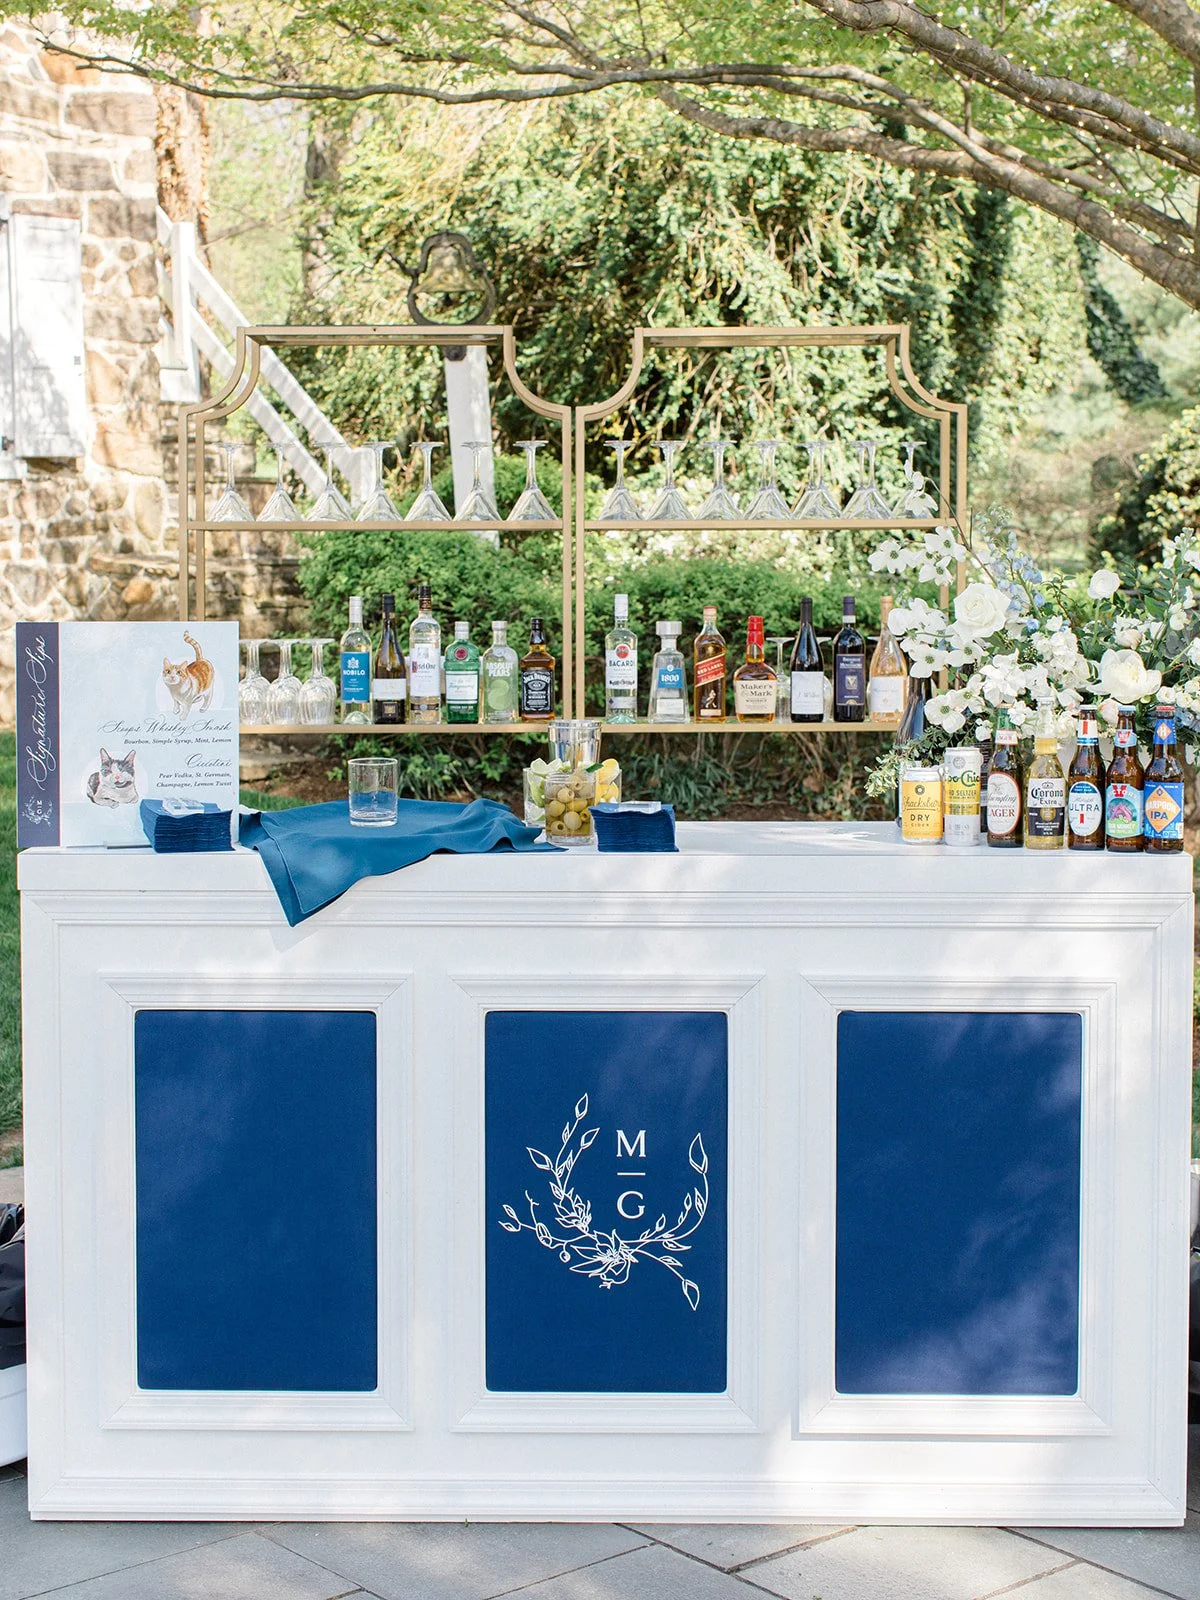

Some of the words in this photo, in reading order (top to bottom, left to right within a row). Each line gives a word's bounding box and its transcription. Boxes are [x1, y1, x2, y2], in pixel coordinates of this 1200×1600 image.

[25, 635, 53, 691] Sips
[661, 674, 680, 682] 1800
[26, 690, 56, 790] Signature
[1031, 787, 1064, 800] Corona
[990, 808, 1015, 818] AGER
[1070, 803, 1100, 812] ULTRA
[910, 814, 930, 822] DRY
[1150, 811, 1169, 820] IPA
[616, 1130, 646, 1157] M
[617, 1191, 646, 1219] G
